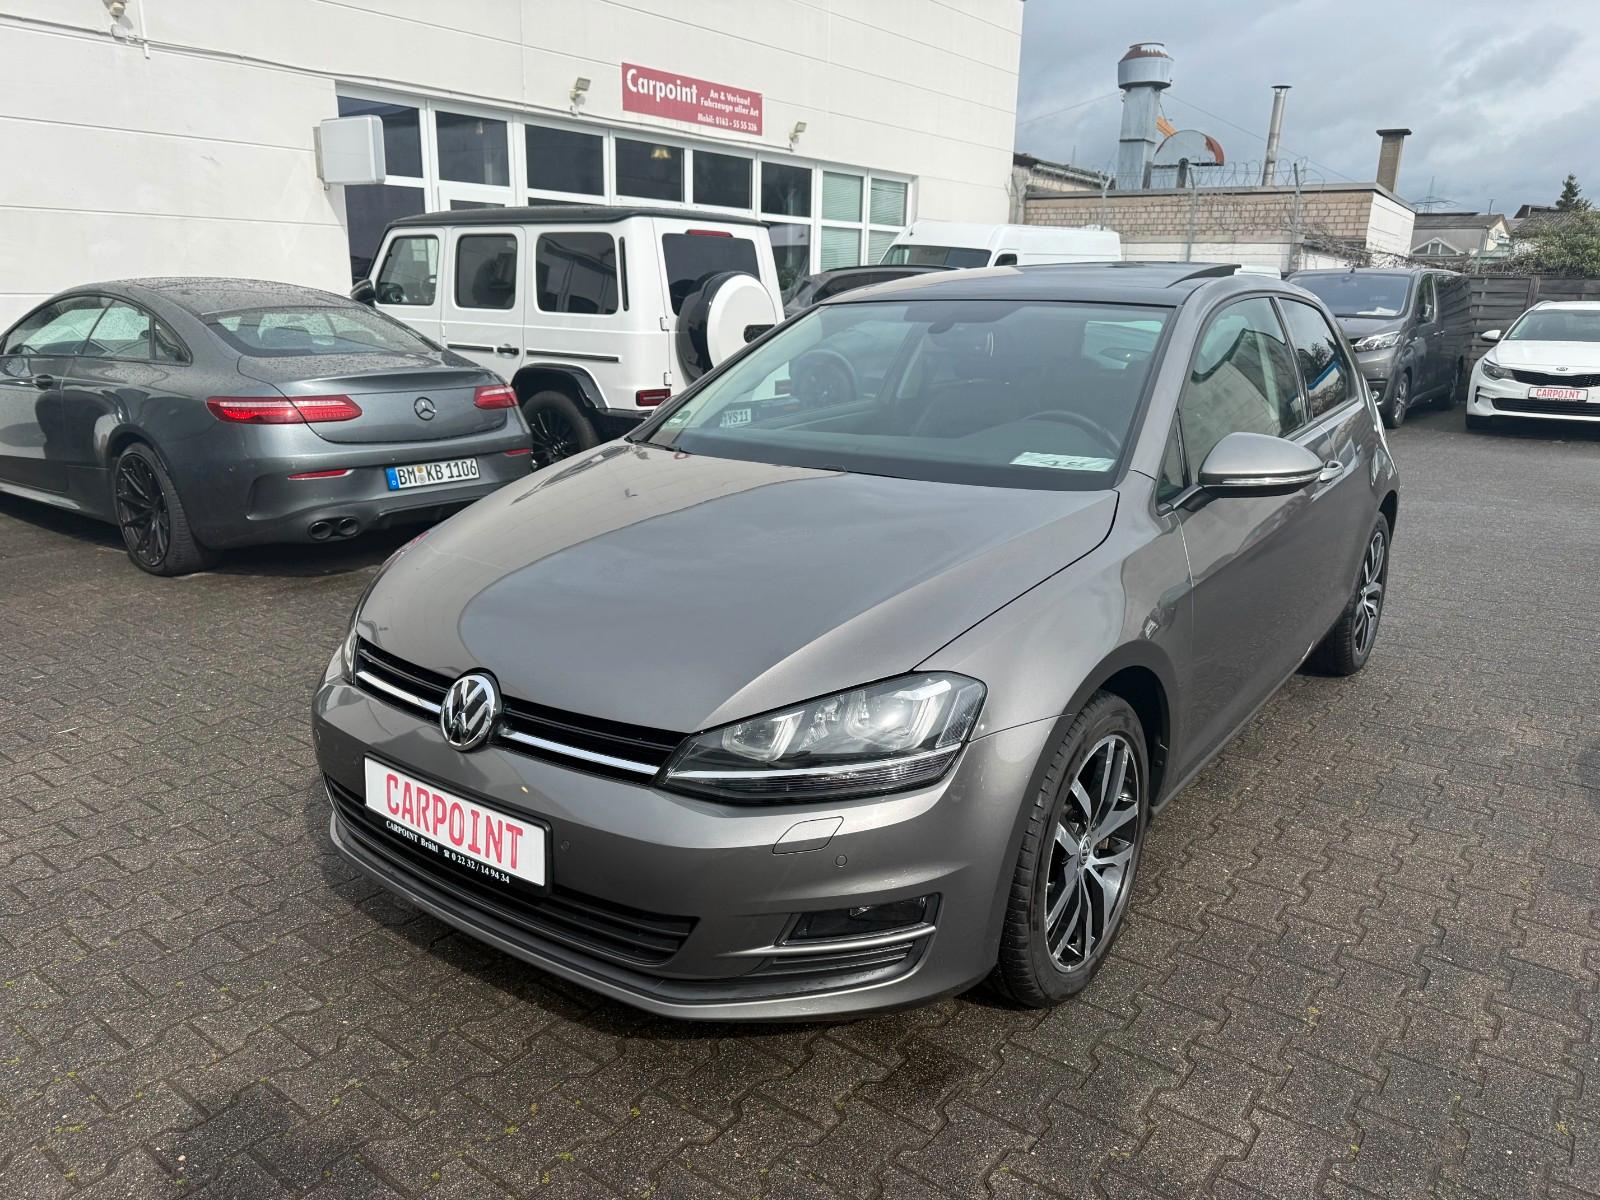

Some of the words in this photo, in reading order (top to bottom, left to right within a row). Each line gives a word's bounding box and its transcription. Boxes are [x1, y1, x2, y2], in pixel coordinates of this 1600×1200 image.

[626, 68, 698, 104] Carpoint
[700, 97, 734, 113] Fahrzeuge
[734, 105, 749, 115] aller
[749, 107, 759, 117] Art
[710, 89, 718, 99] An
[720, 92, 725, 100] &
[726, 93, 751, 106] Verkauf
[697, 112, 715, 123] Mobil:
[1536, 388, 1581, 399] CARPOINT
[397, 468, 417, 485] BM
[425, 464, 443, 481] KB
[445, 460, 477, 479] 1106
[386, 773, 523, 869] CARPOINT
[386, 820, 419, 843] CARPOINT
[420, 838, 439, 853] Brühl
[451, 852, 456, 861] 0
[457, 855, 466, 865] 22
[467, 859, 475, 870] 32
[480, 865, 489, 876] 14
[490, 869, 499, 880] 94
[500, 873, 510, 884] 34
